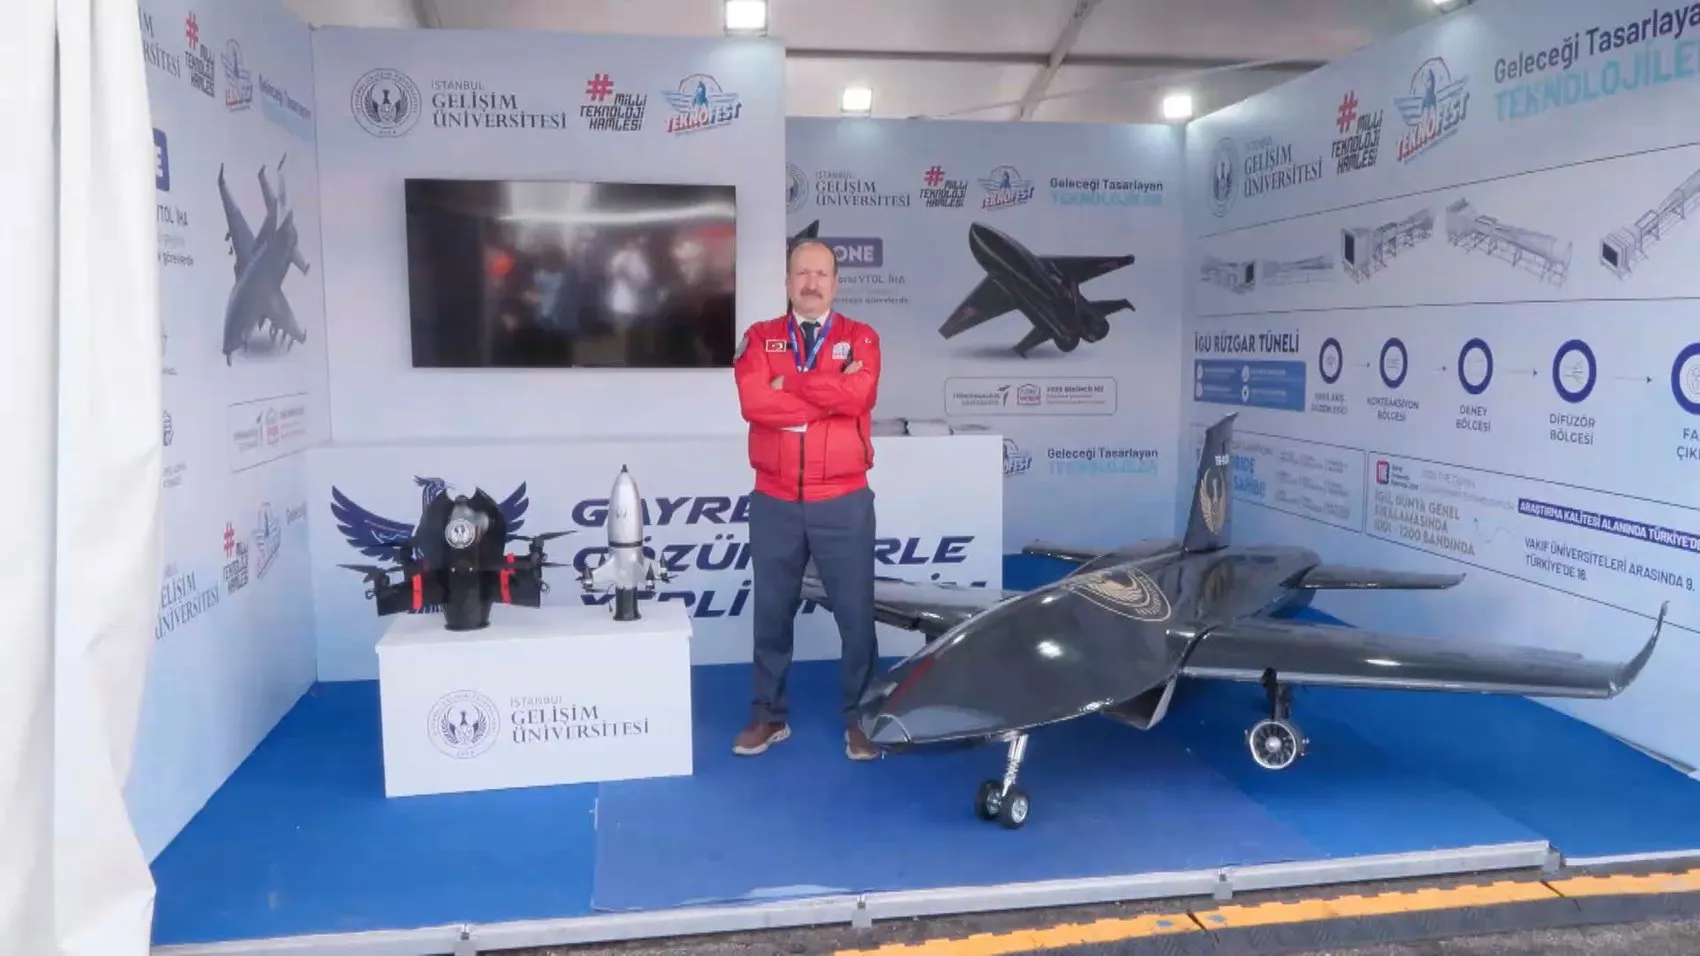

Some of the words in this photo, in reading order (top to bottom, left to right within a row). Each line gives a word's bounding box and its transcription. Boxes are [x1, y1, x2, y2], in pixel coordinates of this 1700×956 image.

[1494, 32, 1580, 84] Geleceği
[431, 79, 485, 91] İSTANBUL
[1494, 37, 1700, 122] TEKNOLOJİLE
[432, 91, 518, 112] GELİŞİM
[580, 105, 645, 119] TEKNOLOJİ
[433, 110, 567, 129] ÜNİVERSİTESİ
[589, 117, 643, 132] HAMLESİ
[666, 102, 742, 133] TEKNOFEST
[1244, 143, 1292, 175] GELİŞİM
[815, 179, 876, 196] GELİŞİM
[1050, 177, 1100, 192] Geleceği
[1103, 179, 1163, 192] Tasarlayan
[1244, 155, 1322, 198] ÜNİVERSİTESİ
[816, 193, 911, 207] ÜNİVERSİTESİ
[1214, 331, 1256, 353] RÜZGAR
[1259, 329, 1301, 353] TÜNELİ
[1460, 404, 1487, 416] DENEY
[1456, 417, 1491, 432] BÖLGESİ
[1550, 429, 1594, 446] BÖLGESİ
[1047, 448, 1097, 461] Geleceği
[1099, 447, 1159, 461] Tasarlayan
[1520, 500, 1564, 521] ARAŞTIRMA
[1564, 510, 1601, 528] KALİTESİ
[1602, 518, 1648, 539] ALANINDA
[1423, 531, 1476, 557] BANDINDA
[1525, 537, 1549, 552] VAKIF
[1550, 540, 1627, 574] ÜNİVERSİTELERİ
[1628, 563, 1684, 588] ARASINDA
[1686, 578, 1696, 591] 9.
[1526, 552, 1576, 578] TÜRKİYE'DE
[511, 704, 599, 727] GELİŞİM
[512, 717, 650, 744] ÜNİVERSİTESİ
